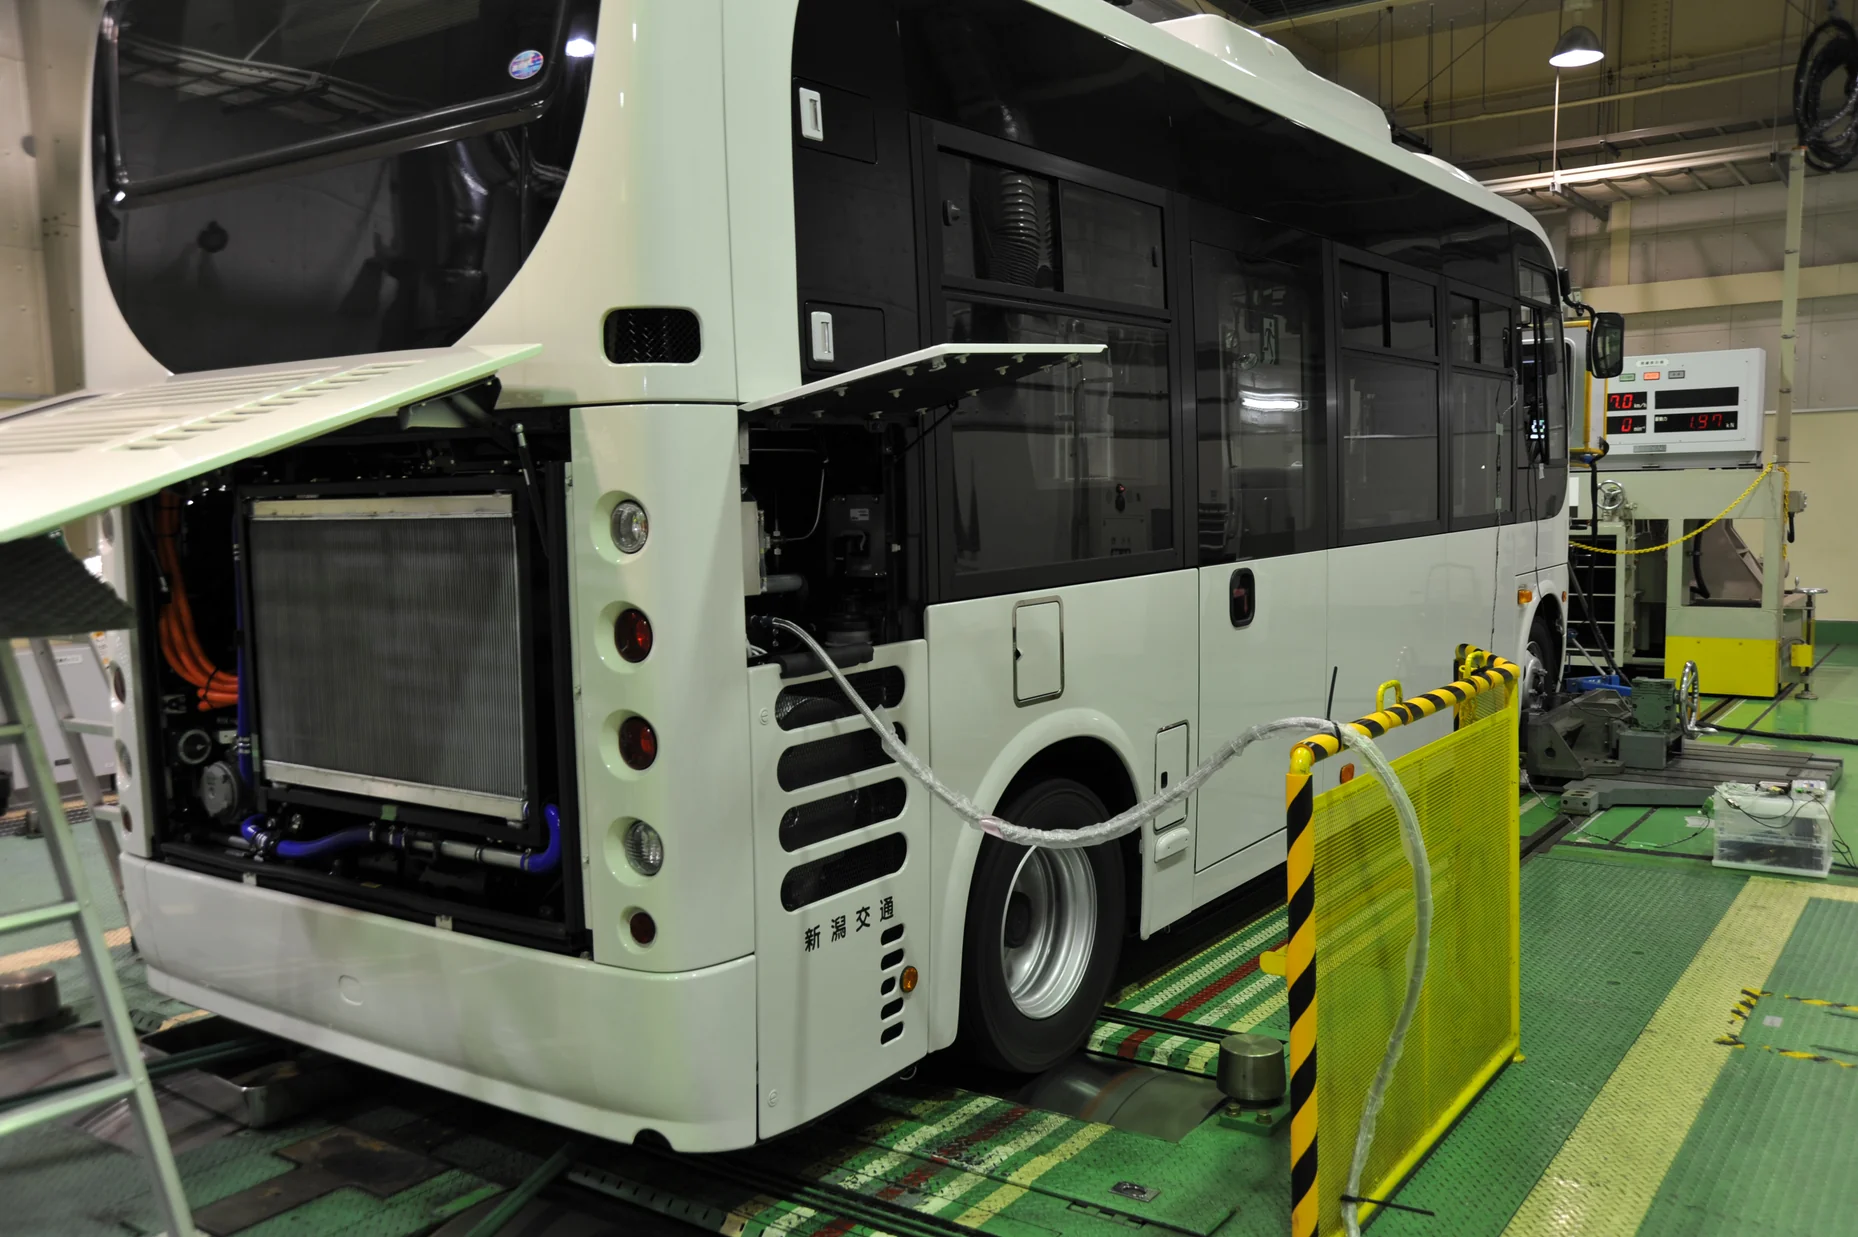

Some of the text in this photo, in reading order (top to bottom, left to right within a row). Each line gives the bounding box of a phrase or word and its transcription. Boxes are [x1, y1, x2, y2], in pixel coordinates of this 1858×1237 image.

[1621, 417, 1633, 433] 0
[804, 896, 894, 953] 新潟交通
